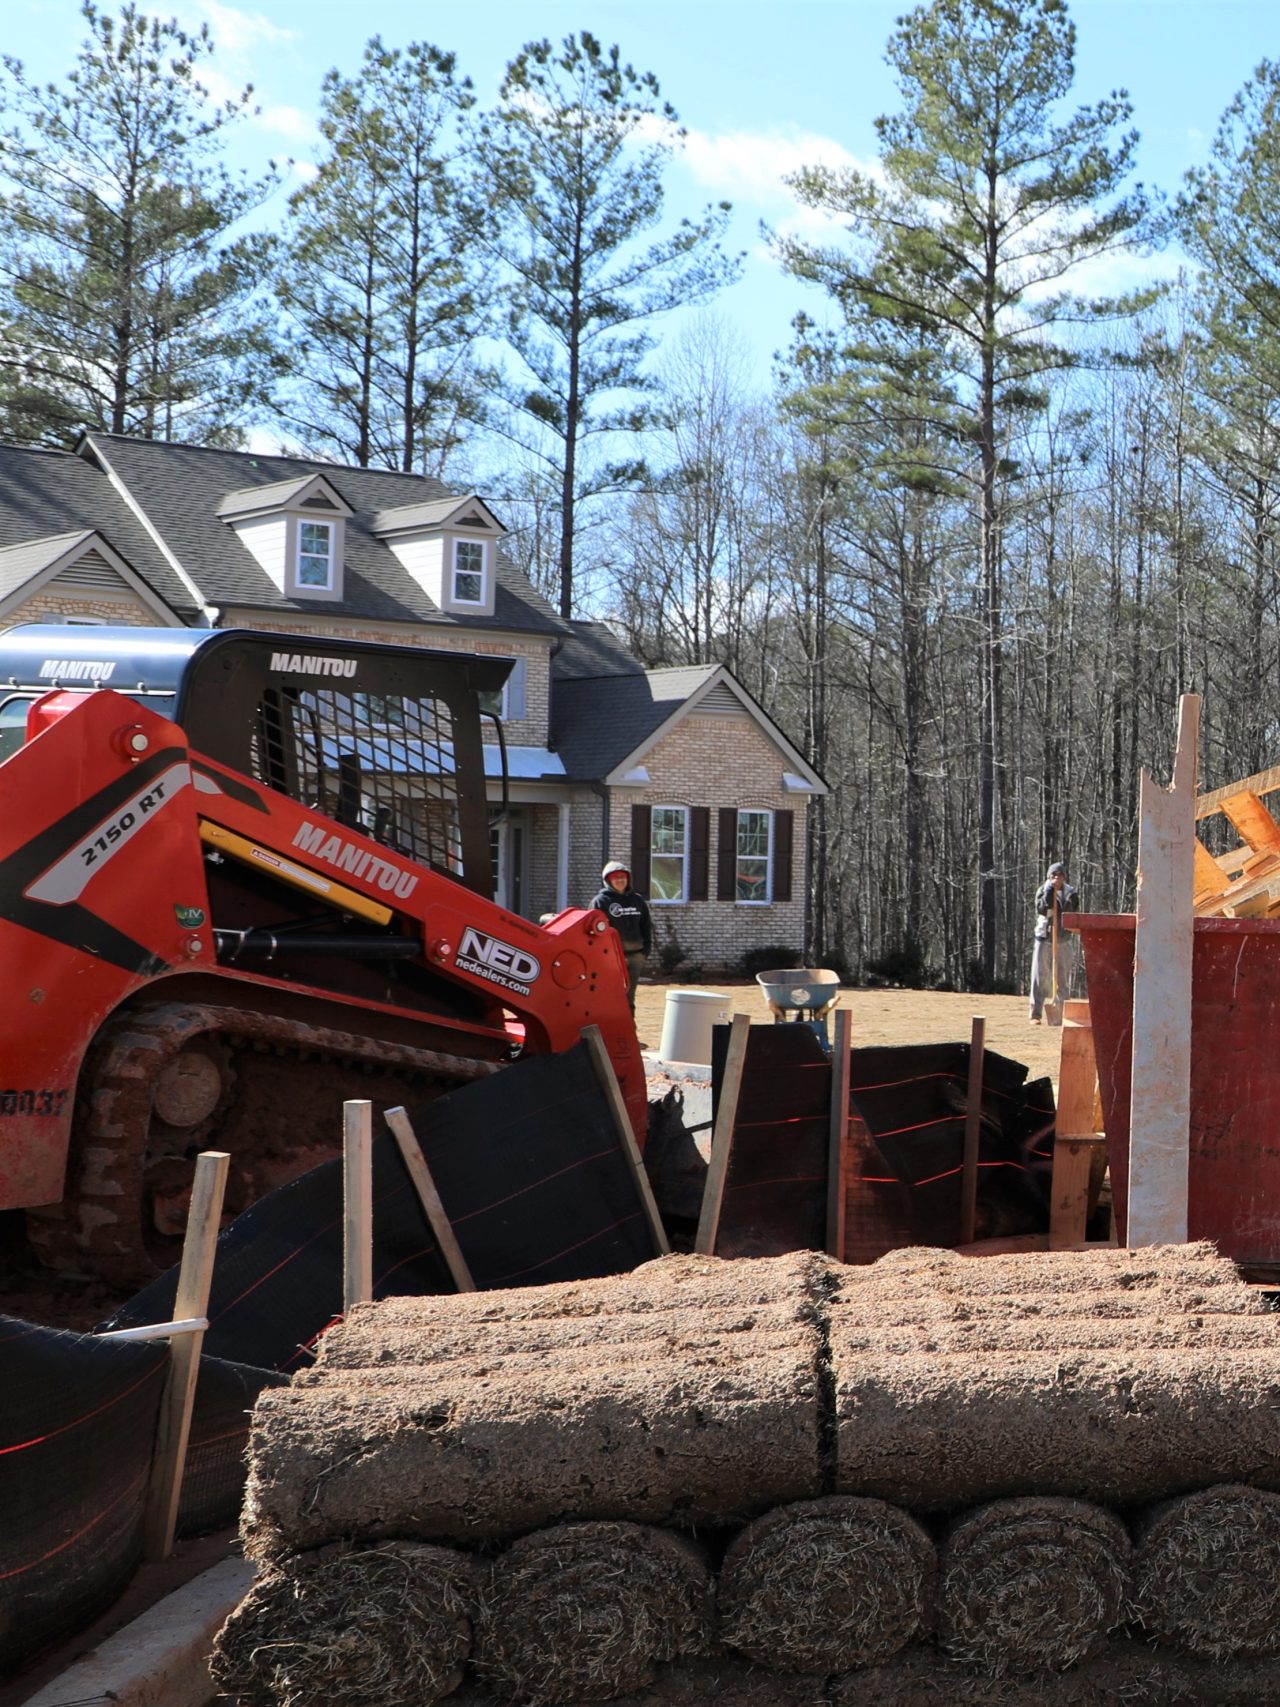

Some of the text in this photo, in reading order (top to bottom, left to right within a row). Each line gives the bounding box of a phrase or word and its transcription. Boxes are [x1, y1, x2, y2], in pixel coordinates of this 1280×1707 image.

[39, 660, 116, 681] MANITOU
[270, 652, 358, 678] MANITOU
[80, 782, 167, 867] 2150 RT
[291, 821, 419, 899] MANITOU
[455, 958, 530, 996] nedealers.com
[460, 930, 539, 981] NED
